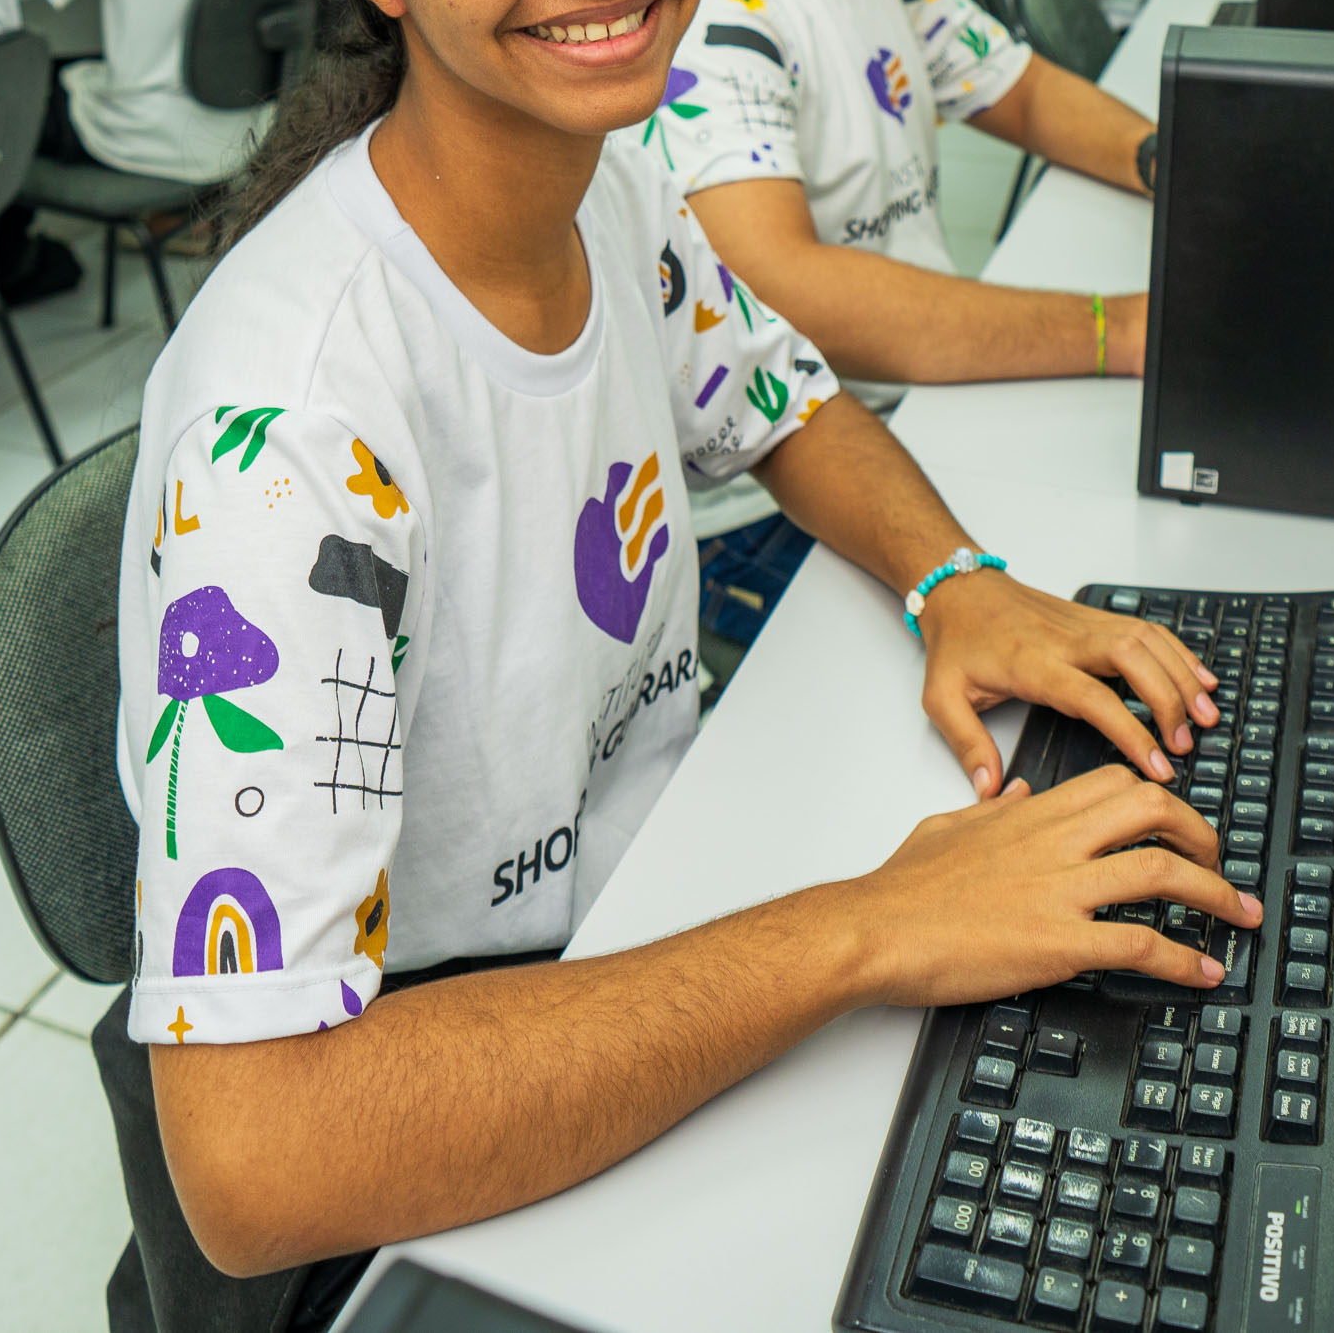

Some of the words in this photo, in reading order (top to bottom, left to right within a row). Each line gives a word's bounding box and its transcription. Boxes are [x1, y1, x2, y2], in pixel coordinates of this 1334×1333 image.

[1225, 939, 1237, 972] Backspace
[1158, 1047, 1167, 1060] End
[1212, 1048, 1222, 1070] Home
[1287, 1056, 1297, 1073] Lock
[1143, 1084, 1154, 1105] Down
[1155, 1086, 1167, 1105] Page
[1199, 1089, 1210, 1101] Up
[1212, 1091, 1224, 1110] Page
[1300, 1098, 1311, 1119] Pause
[1128, 1140, 1140, 1162] Home
[1148, 1143, 1162, 1153] 7
[1192, 1145, 1204, 1165] Lock
[1204, 1147, 1215, 1167] Num
[969, 1161, 984, 1178] 00
[1140, 1188, 1156, 1199] 8
[954, 1205, 973, 1230] 000
[1132, 1236, 1148, 1248] 9
[1259, 1211, 1285, 1303] POSITIVO
